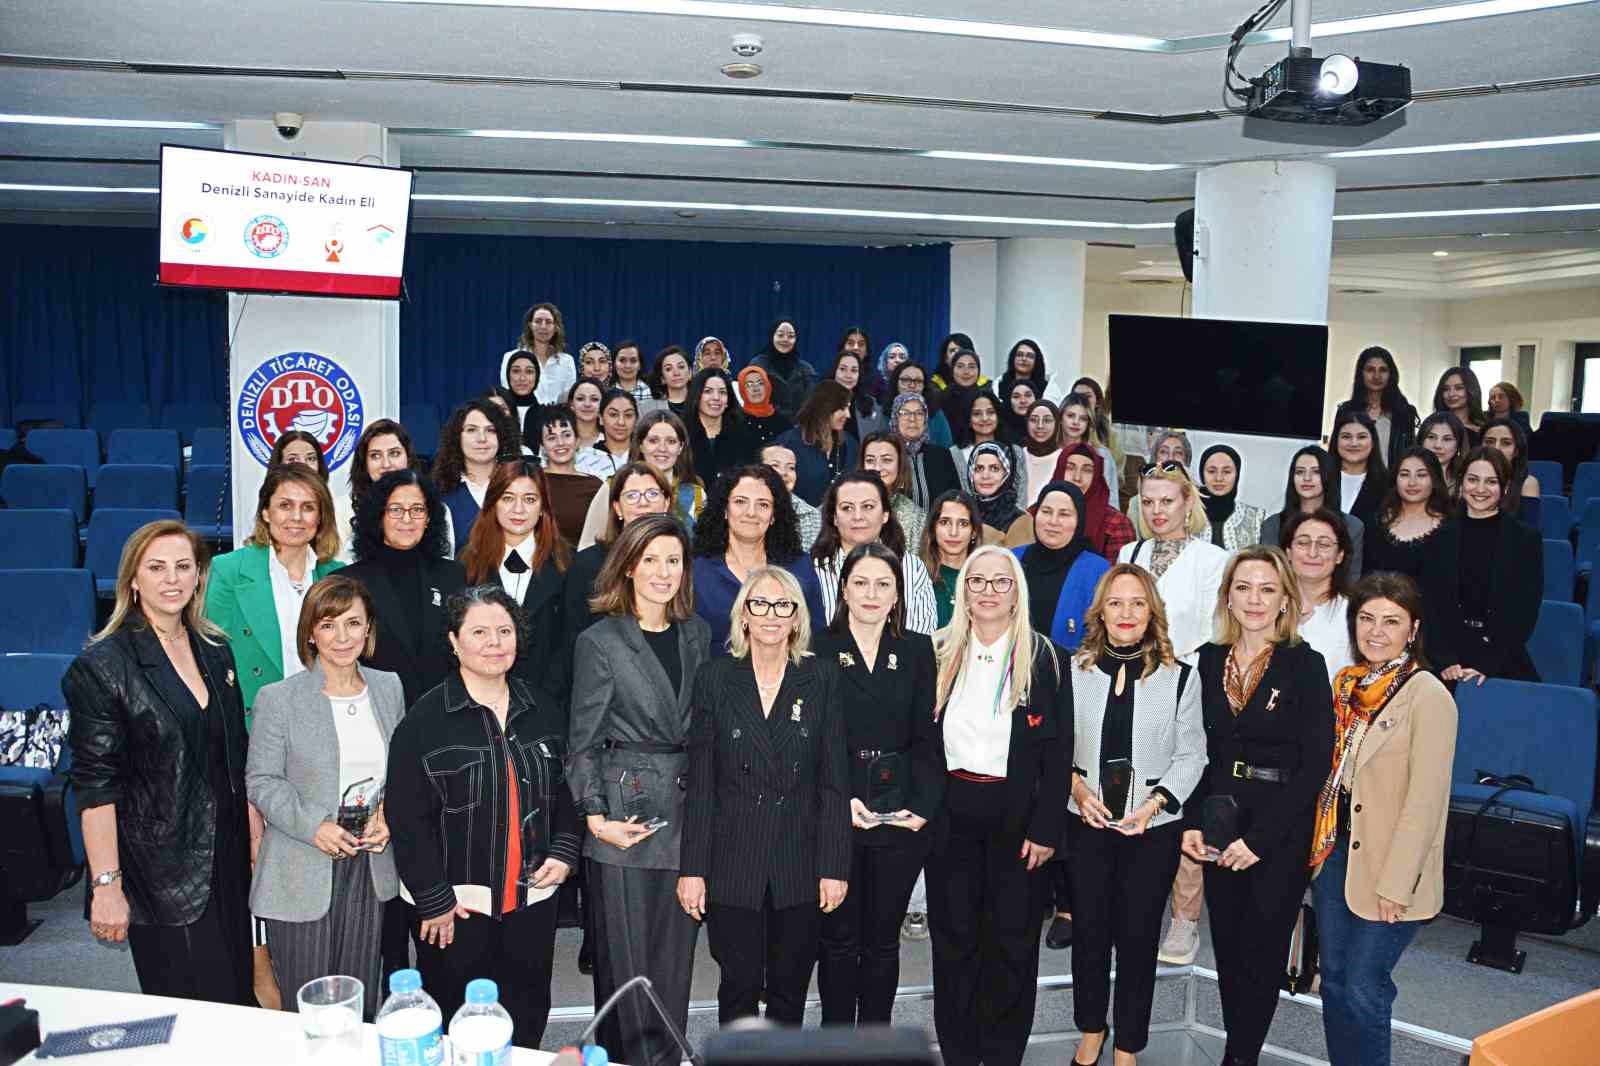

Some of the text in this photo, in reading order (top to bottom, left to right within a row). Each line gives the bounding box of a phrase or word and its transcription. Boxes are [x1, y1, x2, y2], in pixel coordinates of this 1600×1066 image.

[252, 171, 331, 188] KADIN-SAN
[201, 183, 375, 209] Denizli Sanayide Kadın Eli
[269, 356, 335, 376] TİCARET
[336, 377, 361, 427] ODASI
[270, 379, 334, 409] DTO
